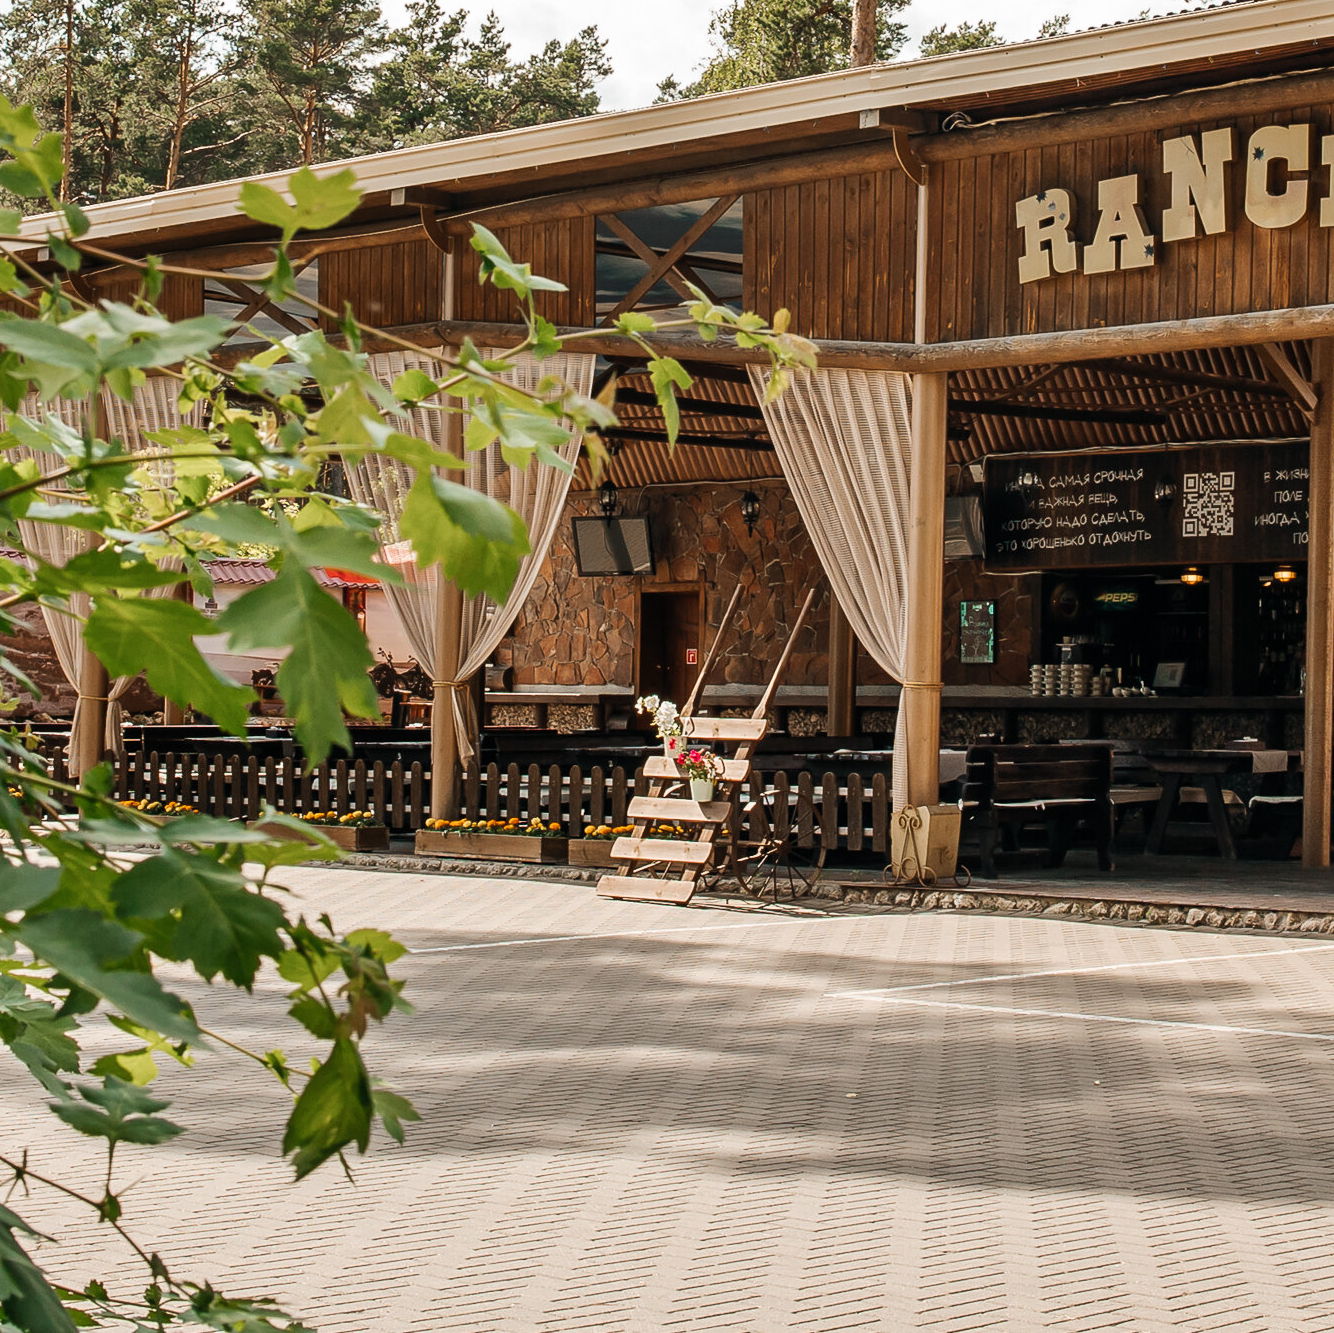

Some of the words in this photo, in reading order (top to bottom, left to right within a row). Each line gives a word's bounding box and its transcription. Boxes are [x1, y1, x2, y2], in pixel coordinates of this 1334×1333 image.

[1049, 473, 1090, 489] САМАЯ
[1093, 468, 1144, 484] СРОЧНАЯ
[1263, 471, 1271, 483] В
[1275, 468, 1310, 481] ЖИЗН
[1038, 494, 1085, 509] ВАЖНАЯ
[1088, 492, 1118, 506] ВЕЩЬ,
[1274, 490, 1303, 503] ПОЛЕ
[1002, 516, 1052, 532] КОТОРУЮ
[1056, 514, 1087, 528] НАДО
[1091, 509, 1146, 525] СДЕЛАТЬ,
[1254, 511, 1300, 527] ИНОГДА
[995, 539, 1017, 552] ЭТО
[1021, 534, 1085, 550] ХОРОШЕНЬКО
[1088, 529, 1152, 546] ОТДОХНУТЬ
